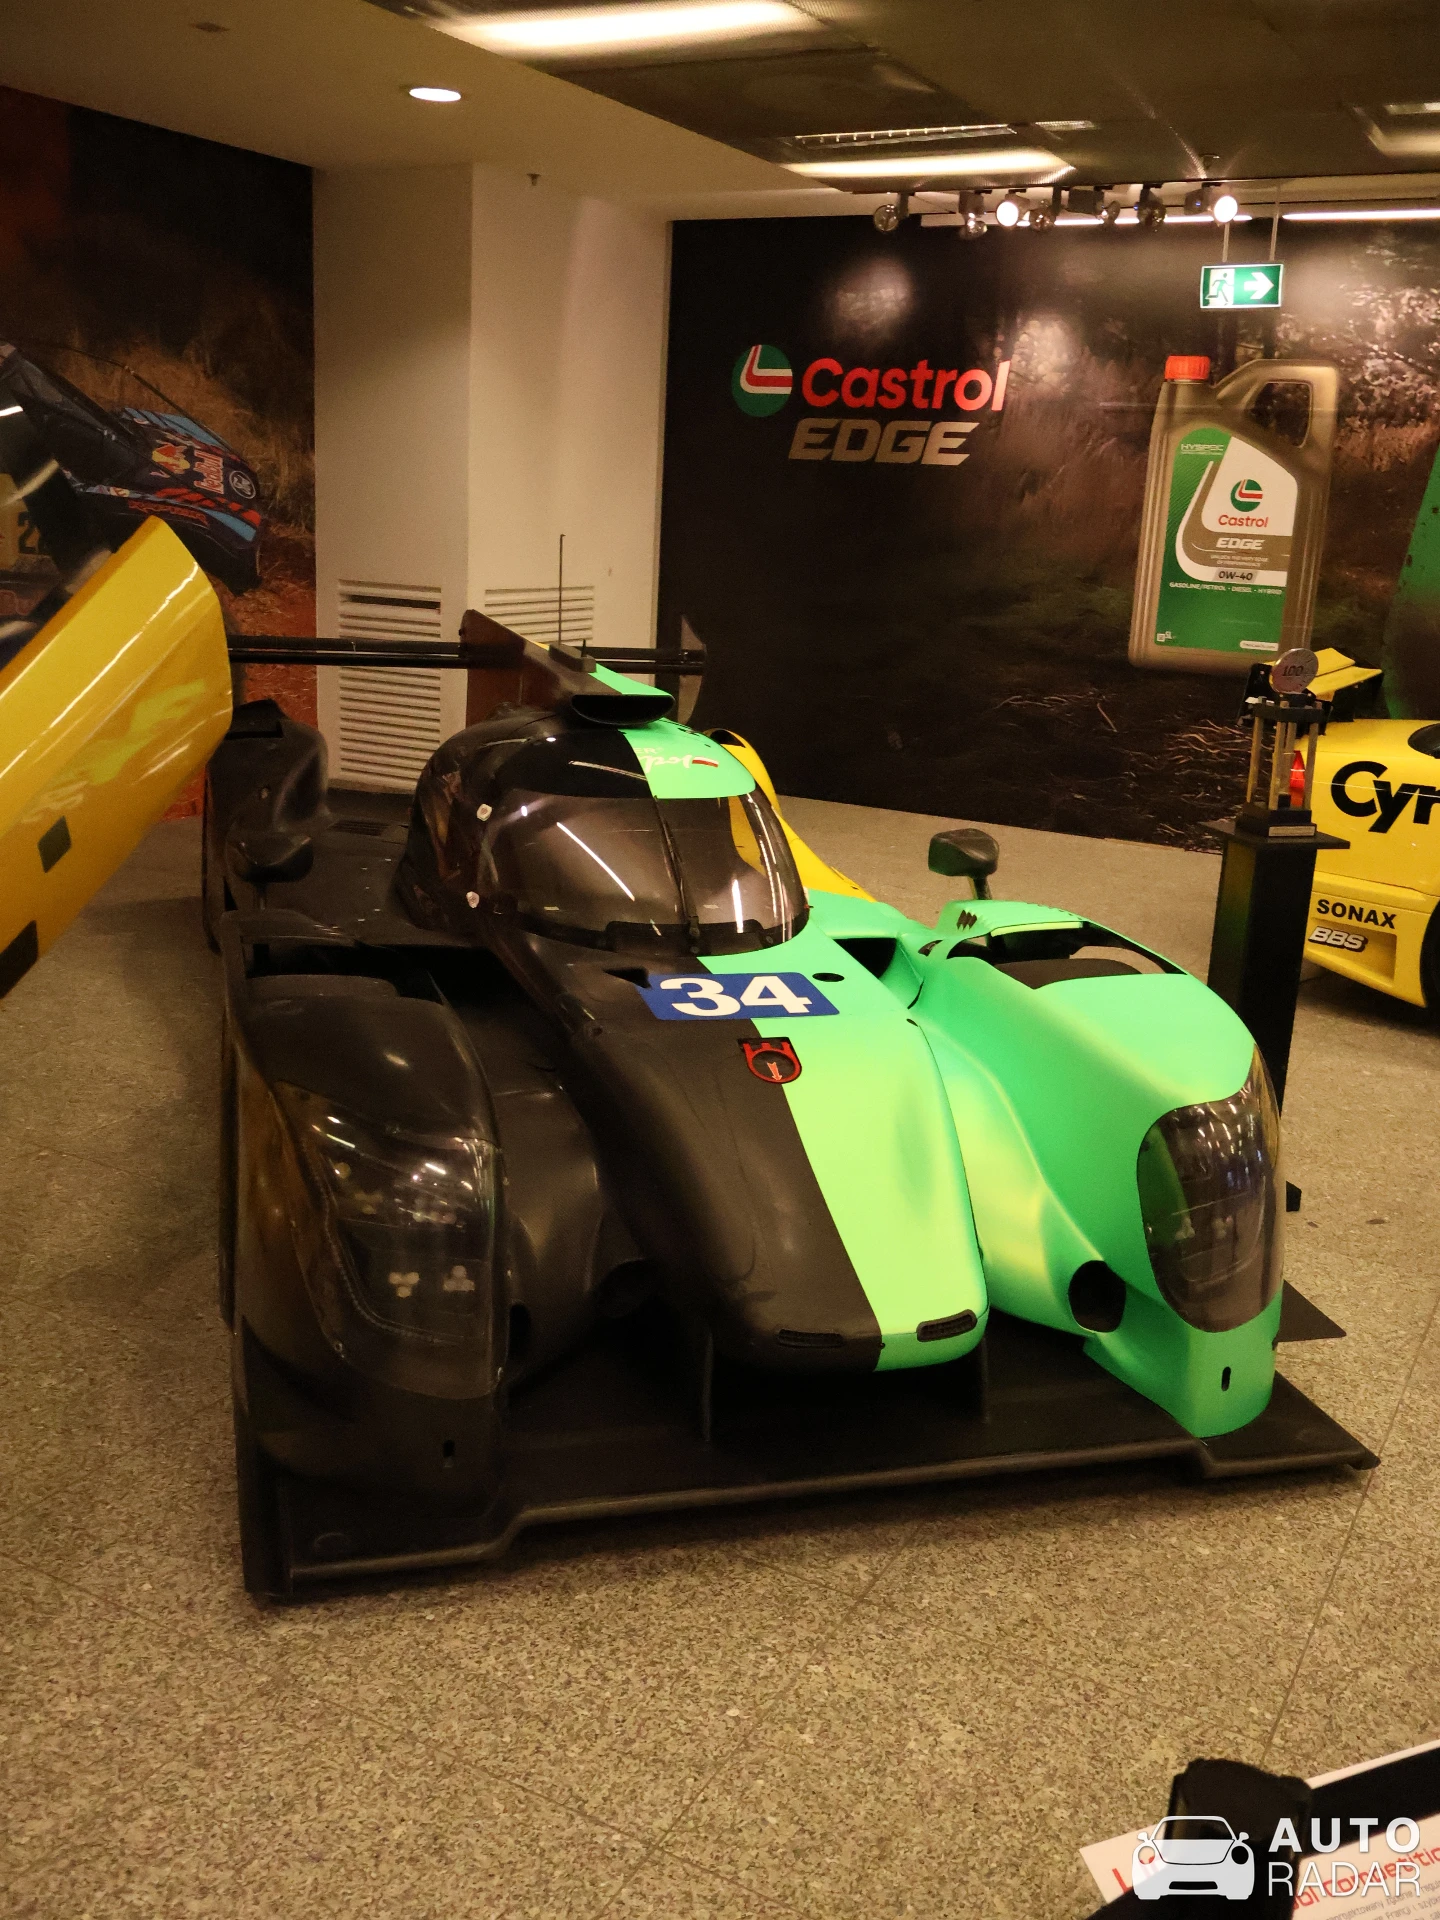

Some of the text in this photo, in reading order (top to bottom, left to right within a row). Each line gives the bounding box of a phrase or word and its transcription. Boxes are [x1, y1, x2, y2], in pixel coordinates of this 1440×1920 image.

[802, 358, 1010, 411] Castrol
[788, 417, 980, 466] EDGE
[1218, 514, 1268, 528] Castrol
[1216, 537, 1265, 550] EDGE
[1218, 570, 1253, 581] 0W-40
[1316, 899, 1397, 929] SONAX
[1308, 926, 1368, 952] BBS
[660, 975, 812, 1017] 34
